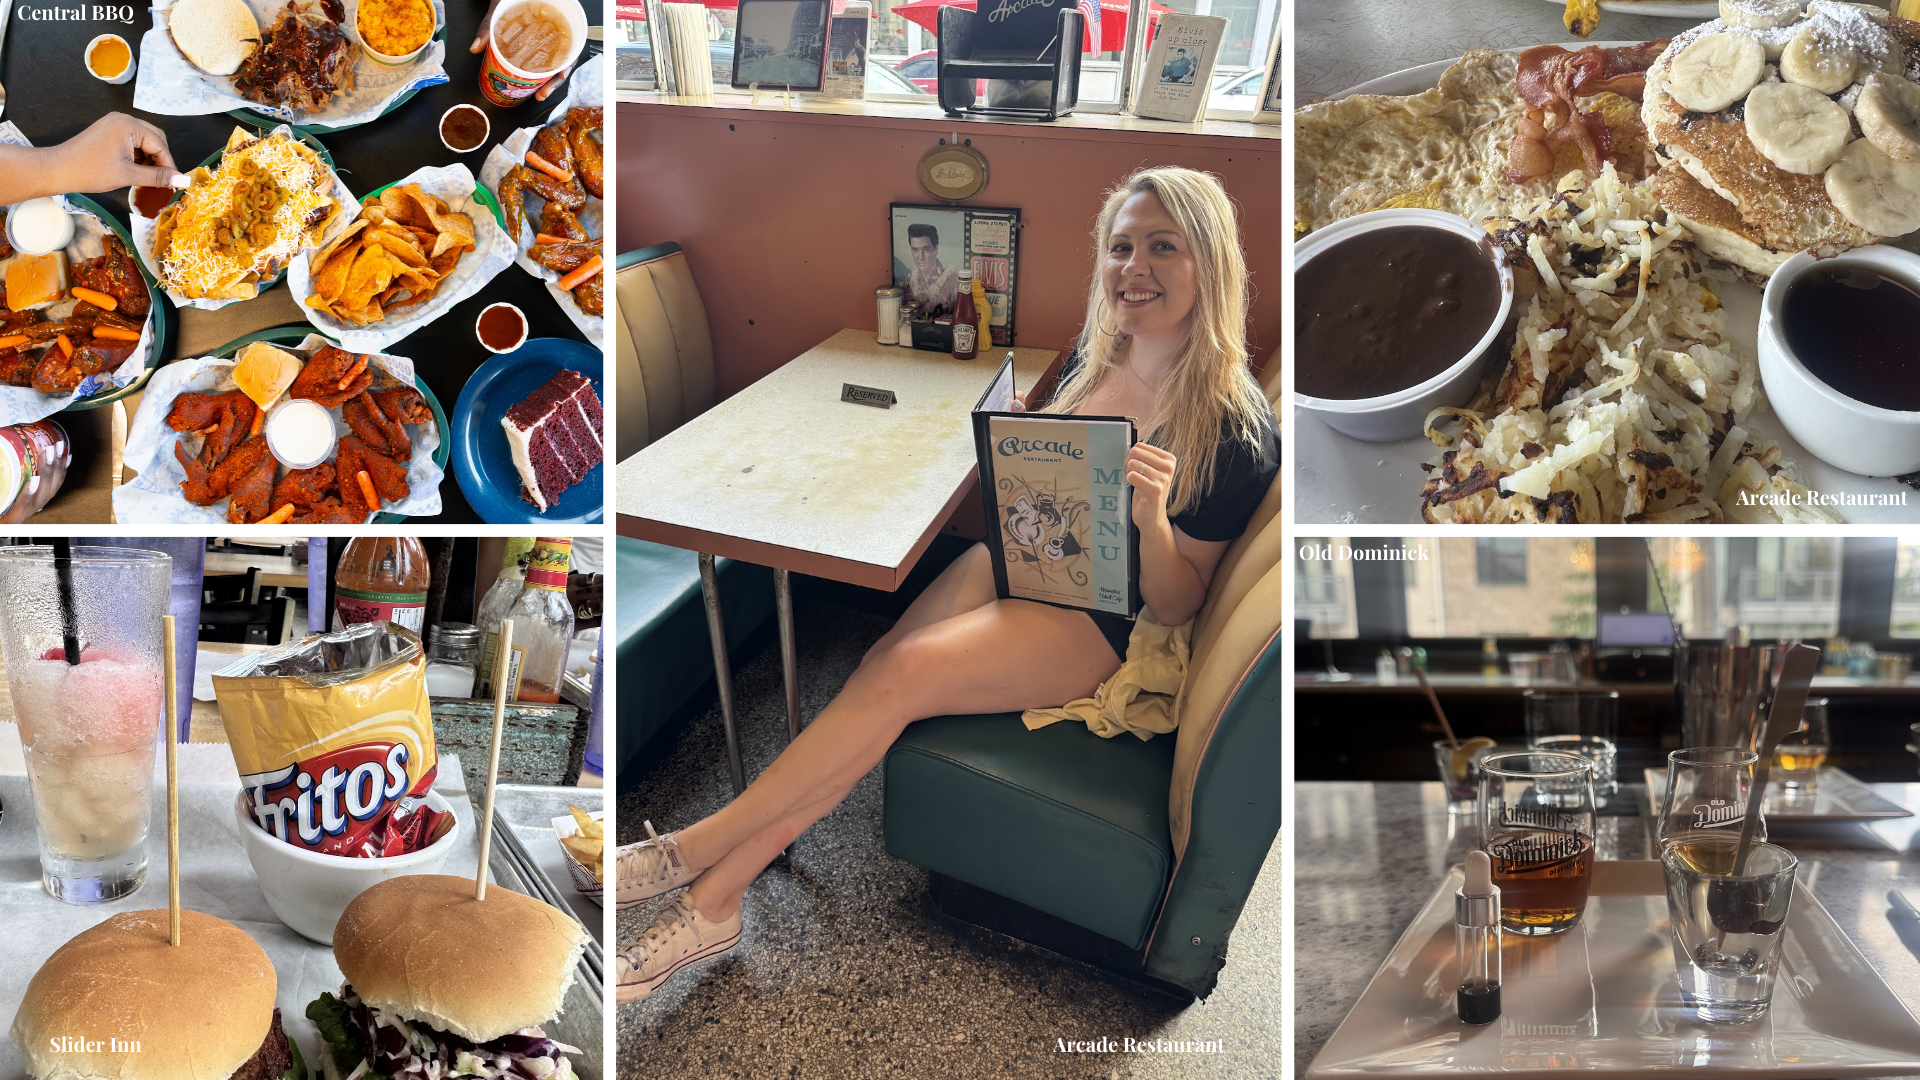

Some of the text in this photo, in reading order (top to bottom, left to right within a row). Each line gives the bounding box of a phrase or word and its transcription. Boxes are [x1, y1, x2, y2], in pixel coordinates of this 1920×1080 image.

[1168, 36, 1208, 46] up close
[1177, 26, 1204, 36] Elvis
[973, 260, 1006, 287] ELVIS
[846, 386, 889, 402] RESERVED
[997, 436, 1085, 461] Arcade
[1093, 467, 1123, 561] MENU
[239, 742, 410, 845] Fritos
[1493, 828, 1583, 874] Dominick
[1512, 839, 1530, 847] OLD
